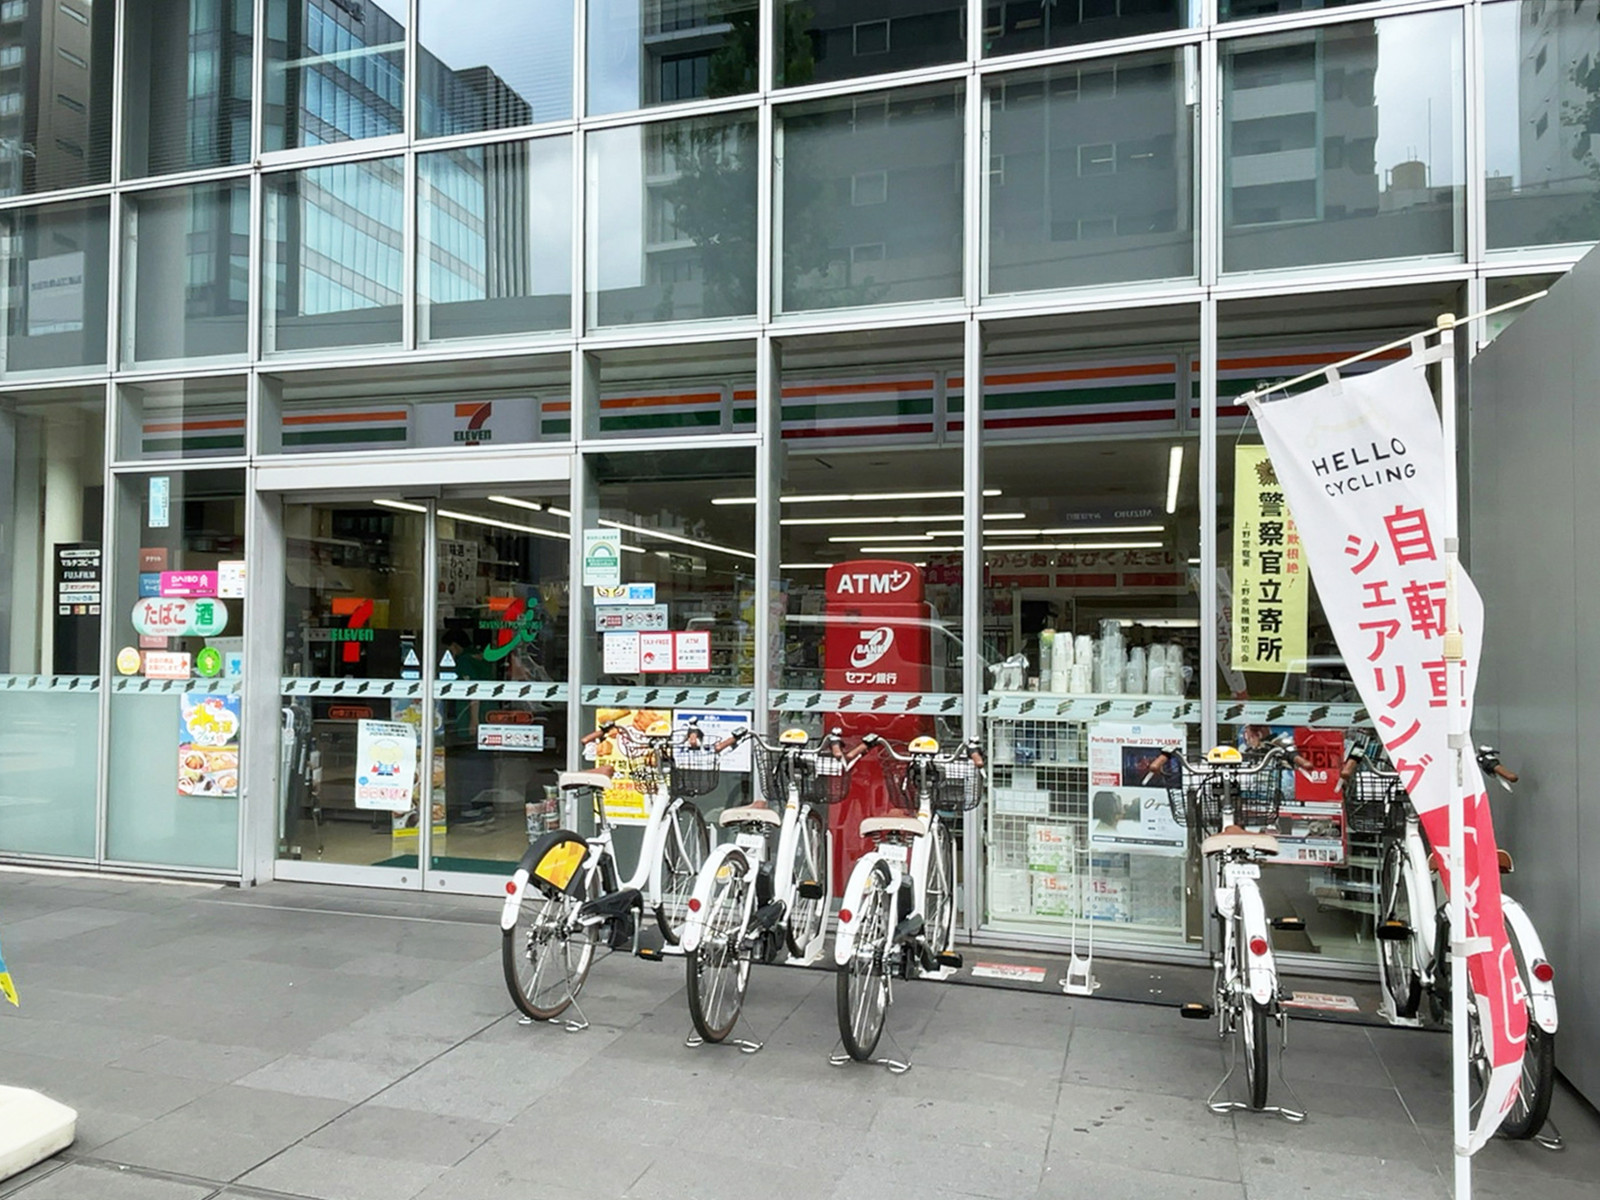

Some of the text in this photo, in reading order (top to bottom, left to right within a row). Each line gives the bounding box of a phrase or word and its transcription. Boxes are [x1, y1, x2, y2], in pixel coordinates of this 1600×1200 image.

[453, 429, 492, 442] ELEVEN
[455, 402, 492, 446] 7
[1311, 437, 1406, 477] HELLO
[1325, 463, 1416, 497] CYCLING
[1257, 492, 1285, 665] 警察官立寄所
[144, 603, 187, 625] たばこ
[195, 602, 214, 626] 酒
[330, 628, 374, 642] ELEVEN
[845, 671, 897, 685] セブン銀行
[1344, 534, 1434, 795] シェアリング
